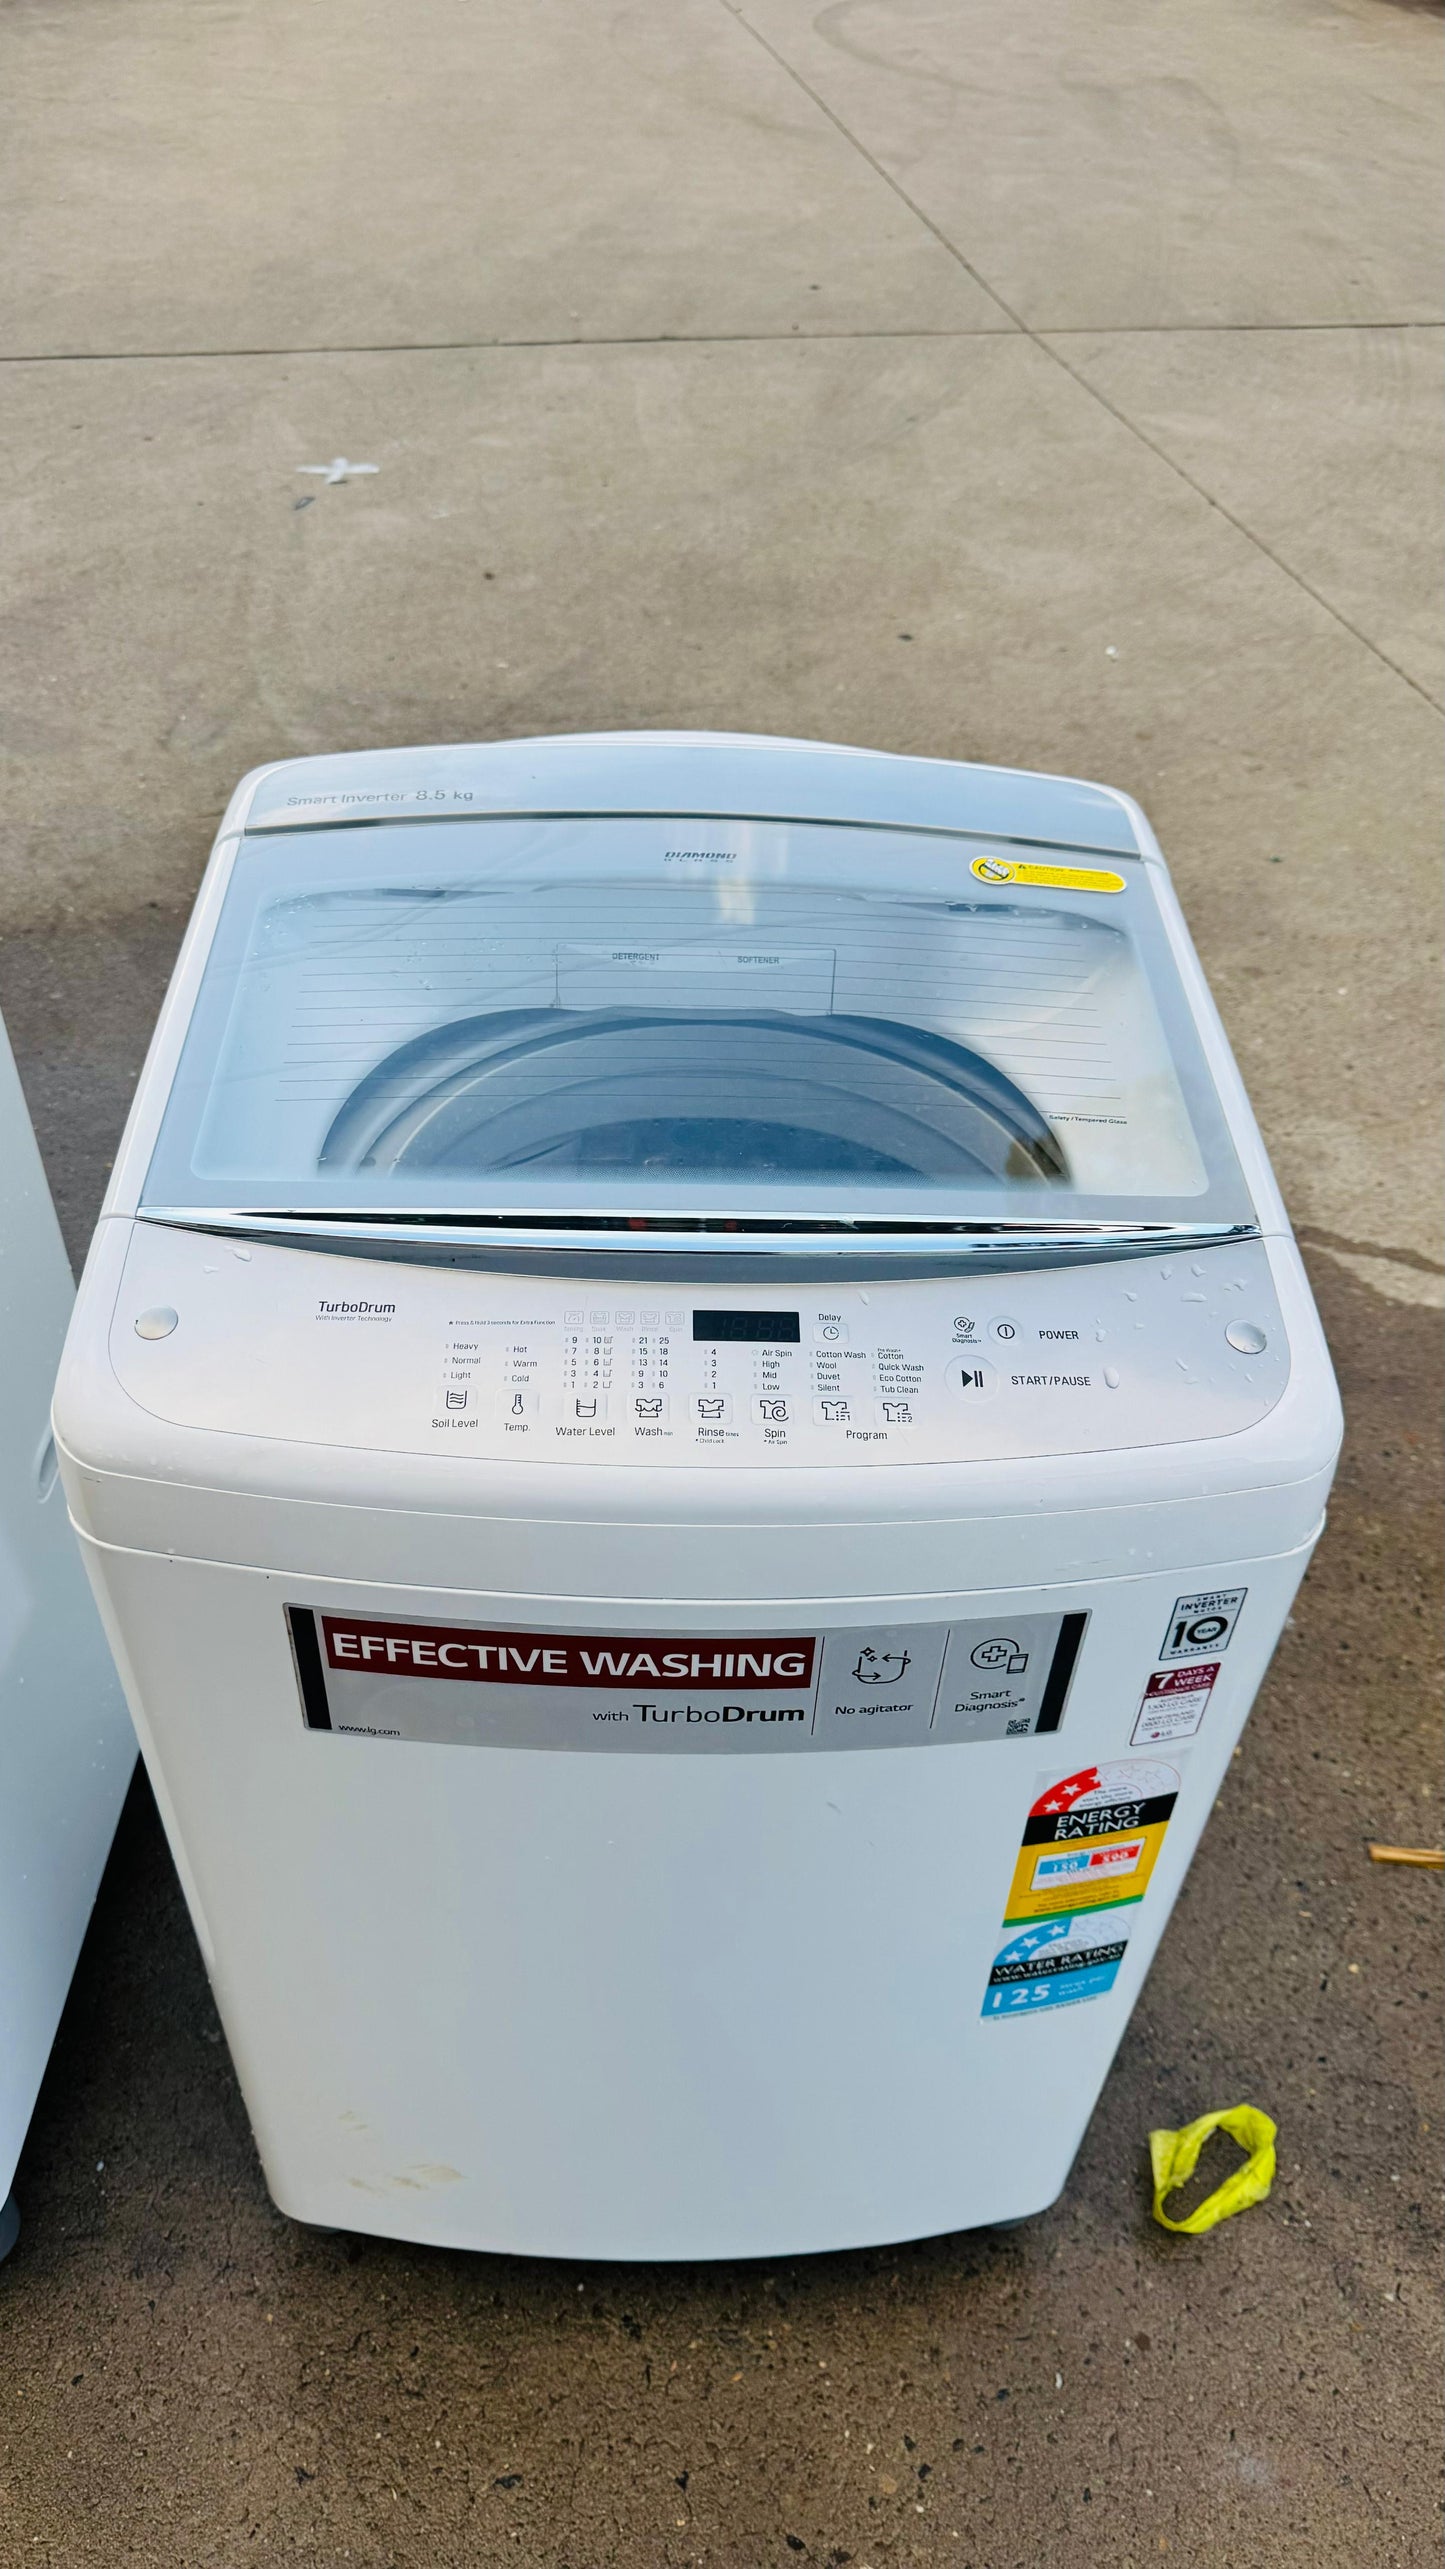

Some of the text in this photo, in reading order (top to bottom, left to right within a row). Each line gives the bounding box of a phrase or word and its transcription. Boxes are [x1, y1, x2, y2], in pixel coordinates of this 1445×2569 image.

[286, 789, 474, 806] Smart Inverter 8.5 kg
[612, 953, 660, 961] DETERGENT
[737, 956, 780, 964] SOFTENER
[319, 1301, 396, 1313] TurboDrum
[818, 1314, 841, 1322] Delay
[1039, 1331, 1079, 1340] POWER
[453, 1342, 478, 1351] Heavy
[513, 1345, 527, 1353] Hot
[572, 1347, 577, 1355] 7
[776, 1350, 792, 1358] Spin
[816, 1351, 866, 1359] Cotton Wash
[878, 1352, 904, 1360] Cotton
[452, 1357, 481, 1365] Normal
[513, 1360, 537, 1368] Warm
[762, 1360, 780, 1369] High
[816, 1361, 837, 1369] Wool
[878, 1363, 924, 1371] Quick Wash
[451, 1371, 471, 1380] Light
[511, 1374, 529, 1382] Cold
[762, 1371, 776, 1379] Mid
[817, 1372, 840, 1380] Duvet
[879, 1374, 921, 1383] Eco Cotton
[593, 1381, 599, 1389] 2
[638, 1381, 664, 1389] 3 6
[1011, 1376, 1091, 1386] START/PAUSE
[432, 1419, 478, 1428] Soil Level
[504, 1423, 531, 1432] Temp.
[556, 1427, 615, 1436] Water Level
[635, 1427, 663, 1436] Wash
[698, 1427, 724, 1436] Rinse
[764, 1429, 786, 1439] Spin
[846, 1430, 888, 1441] Program
[1181, 1597, 1238, 1610] INVERTER
[1172, 1616, 1228, 1648] 10
[333, 1632, 806, 1678] EFFECTIVE WASHING
[1177, 1667, 1204, 1678] DAYS
[1155, 1673, 1173, 1689] 7
[1174, 1674, 1213, 1686] WEEK
[970, 1690, 1012, 1700] Smart
[592, 1704, 805, 1724] with TurboDrum
[835, 1703, 914, 1716] No agitator
[338, 1723, 401, 1737] www.lg.com
[1057, 1802, 1146, 1827] ENERGY
[1054, 1816, 1140, 1840] RATING
[995, 1959, 1055, 1976] WATER
[1061, 1944, 1124, 1965] RATING
